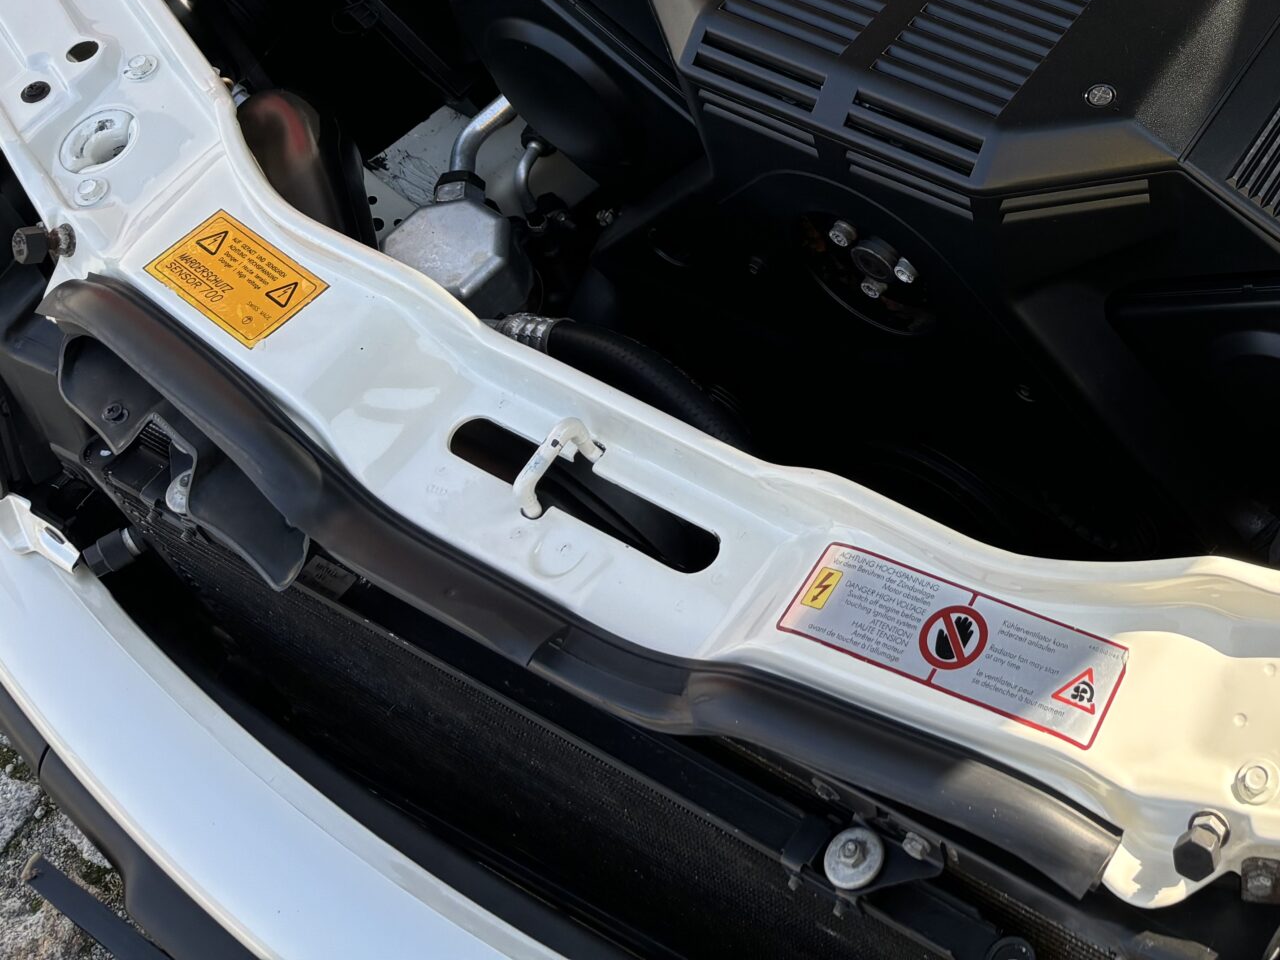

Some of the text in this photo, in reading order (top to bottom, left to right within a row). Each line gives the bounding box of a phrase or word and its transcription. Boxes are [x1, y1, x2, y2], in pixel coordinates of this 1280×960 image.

[177, 253, 233, 294] MARDERSCHUTZ
[217, 257, 232, 269] Danger
[235, 270, 246, 279] High
[245, 278, 261, 290] voltage
[223, 252, 238, 263] Danger
[254, 274, 270, 285] tension
[228, 244, 278, 281] ACHTUNG HOCHSPANNUNG
[165, 262, 223, 303] SENSOR 700
[840, 551, 940, 592] ACHTUNG HOCHSPANNUNG
[843, 561, 857, 570] dem
[857, 566, 884, 580] Berühren
[895, 580, 936, 601] Zündanlage
[844, 581, 926, 615] DANGER HIGH VOLTAGE
[847, 591, 868, 602] Switch
[879, 604, 900, 616] engine
[900, 611, 922, 623] before
[881, 584, 932, 606] Motor abstellen
[844, 599, 918, 631] touching ignition system
[869, 619, 912, 639] ATTENTION!
[808, 623, 826, 633] avant
[835, 633, 861, 647] toucher
[866, 645, 900, 663] l'allumage
[851, 620, 908, 646] HAUTE TENSION
[851, 630, 874, 643] Arrêter
[881, 642, 903, 654] moteur
[997, 628, 1056, 654] jederzeit anlaufen
[1002, 620, 1069, 649] Kühlerventilator kann
[988, 645, 1017, 660] Radiator
[1028, 661, 1043, 671] may
[1045, 666, 1059, 675] start
[992, 656, 1005, 665] any
[1006, 661, 1021, 670] time
[979, 680, 1017, 699] déclencher
[1023, 698, 1036, 707] tout
[1037, 703, 1064, 717] moment
[982, 672, 1018, 690] ventilateur
[1018, 687, 1033, 697] peut
